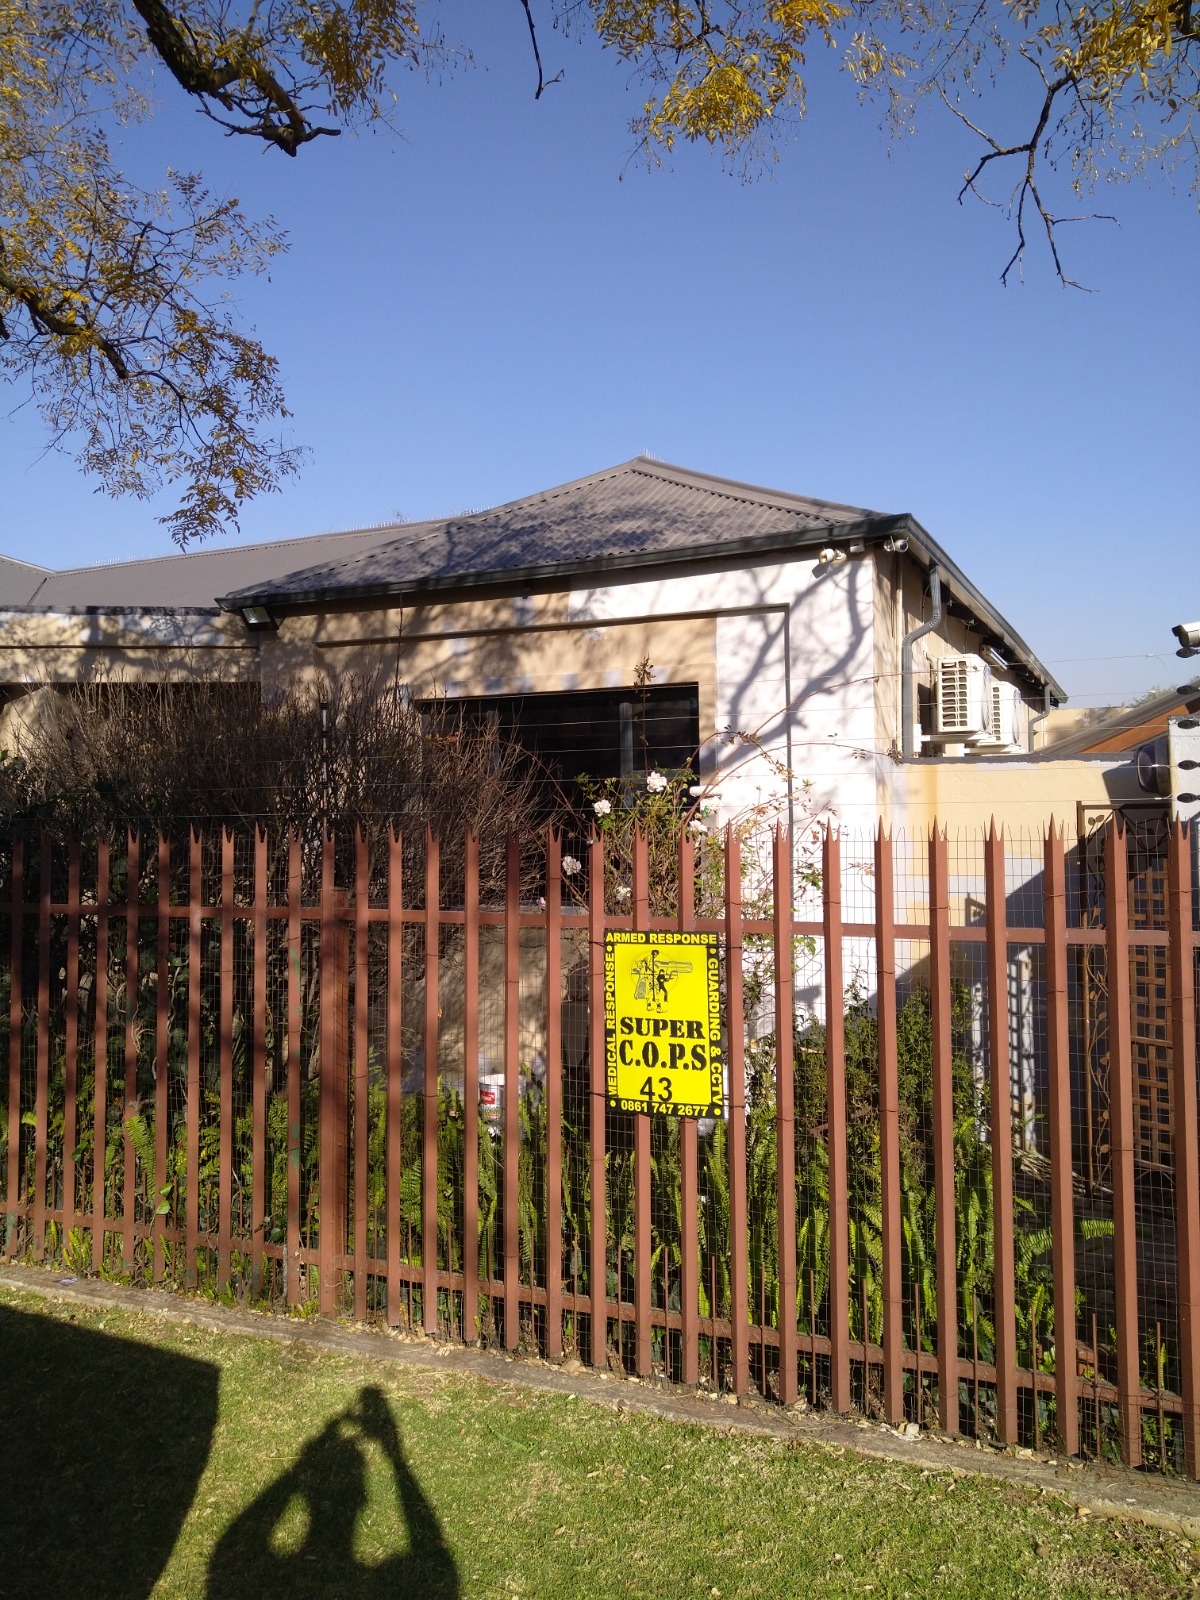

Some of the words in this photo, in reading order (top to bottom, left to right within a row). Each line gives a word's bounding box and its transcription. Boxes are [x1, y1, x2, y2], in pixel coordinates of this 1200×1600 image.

[605, 932, 646, 943] ARMED
[649, 933, 717, 944] RESPONSE
[605, 955, 616, 1029] RESPONSE
[707, 958, 721, 1040] GUARDING
[620, 1016, 706, 1039] SUPER
[606, 1034, 617, 1096] MEDICAL
[619, 1039, 707, 1071] C.O.P.S
[711, 1046, 721, 1057] &
[639, 1076, 673, 1102] 43
[711, 1062, 723, 1105] CCTV
[620, 1101, 648, 1113] 0861
[652, 1103, 674, 1115] 747
[677, 1105, 708, 1117] 2677
